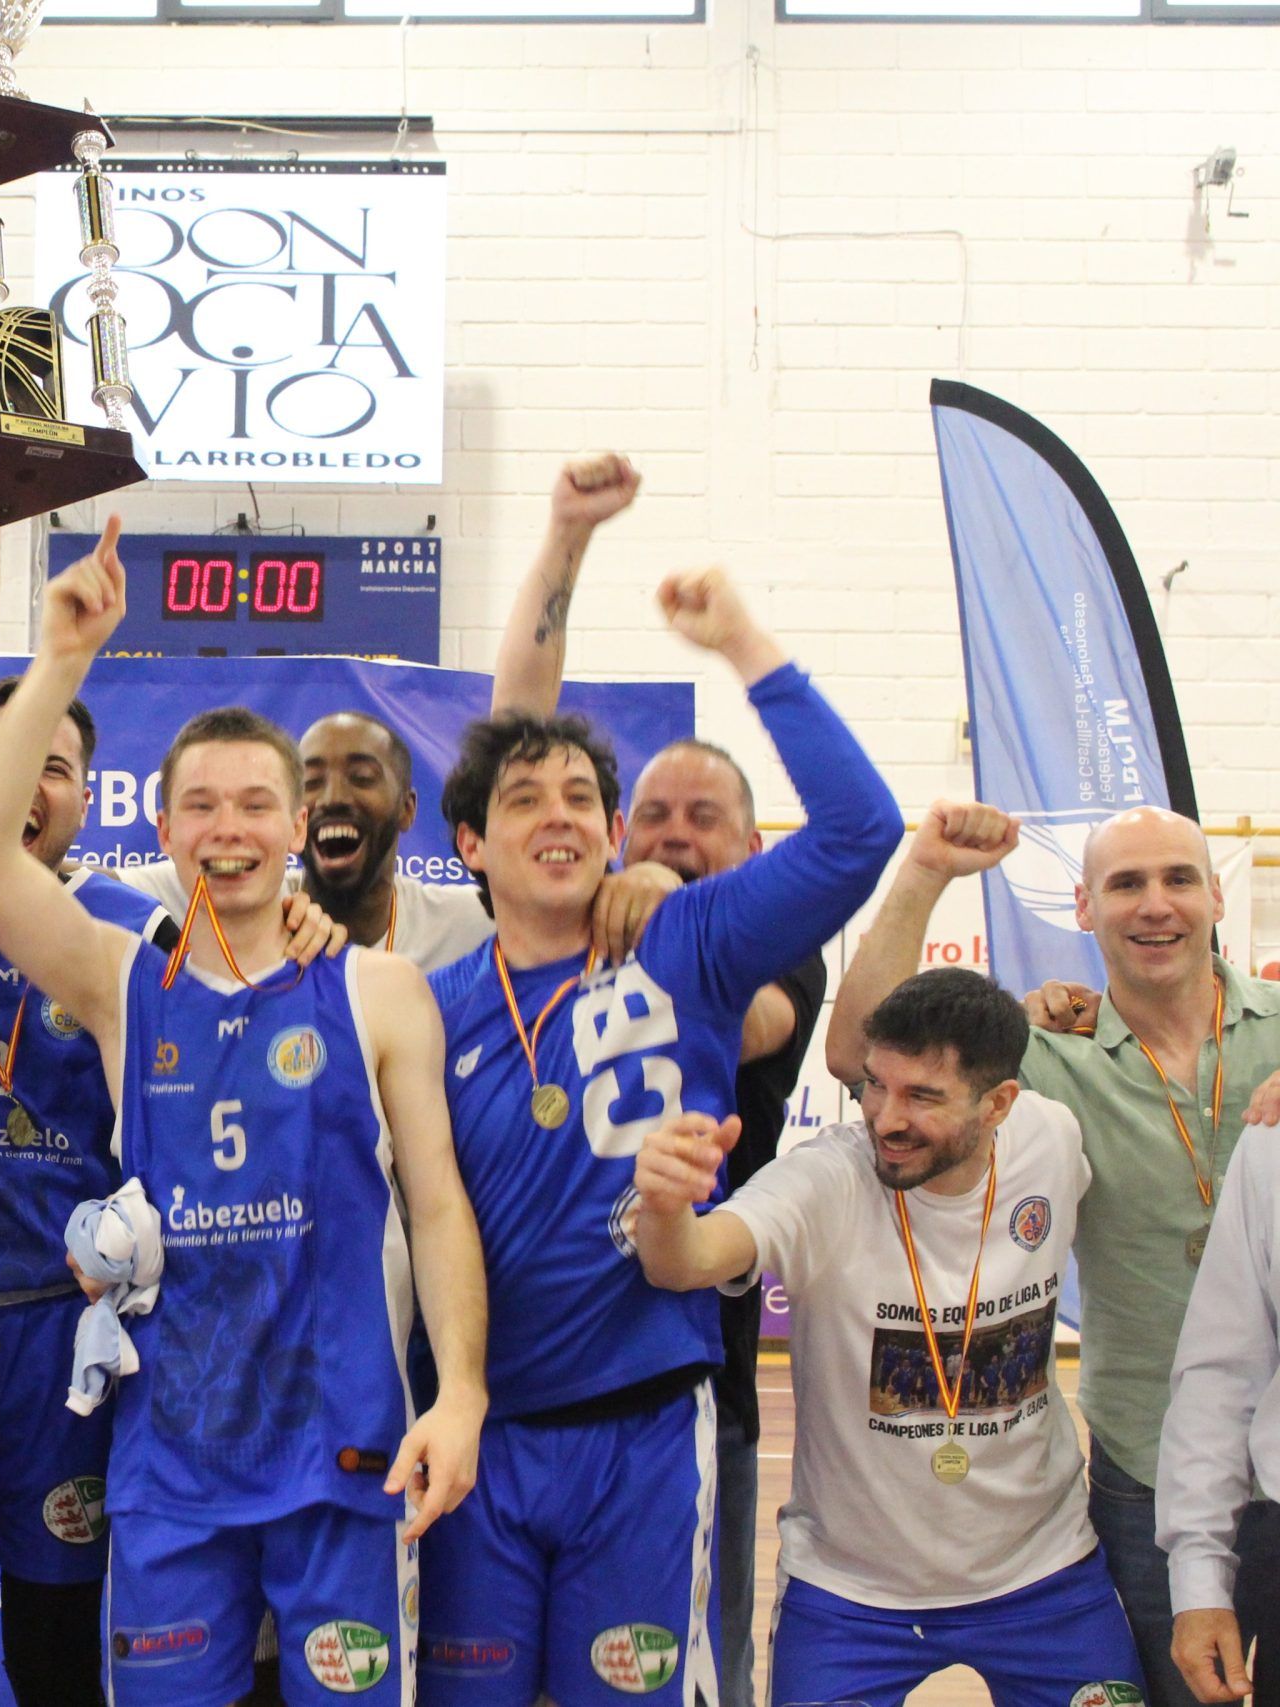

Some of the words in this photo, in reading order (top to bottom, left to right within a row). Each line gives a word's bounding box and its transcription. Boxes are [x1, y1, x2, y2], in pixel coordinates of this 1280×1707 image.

[119, 187, 206, 202] INOS
[113, 207, 370, 269] DON
[150, 450, 421, 469] LARROBLEDO
[361, 541, 437, 555] SPORT
[361, 560, 437, 574] MANCHA
[211, 1099, 247, 1171] 5
[45, 1152, 61, 1164] del
[169, 1191, 303, 1231] Cabezuelo
[210, 1231, 224, 1245] de
[227, 1230, 239, 1244] la
[242, 1228, 273, 1242] tierra
[276, 1227, 284, 1241] y
[942, 1302, 996, 1324] EQUPO
[999, 1295, 1014, 1314] DE
[1015, 1283, 1041, 1307] LIGA
[869, 1418, 944, 1439] CAMPEONES
[948, 1422, 965, 1436] DE
[969, 1422, 999, 1437] LIGA
